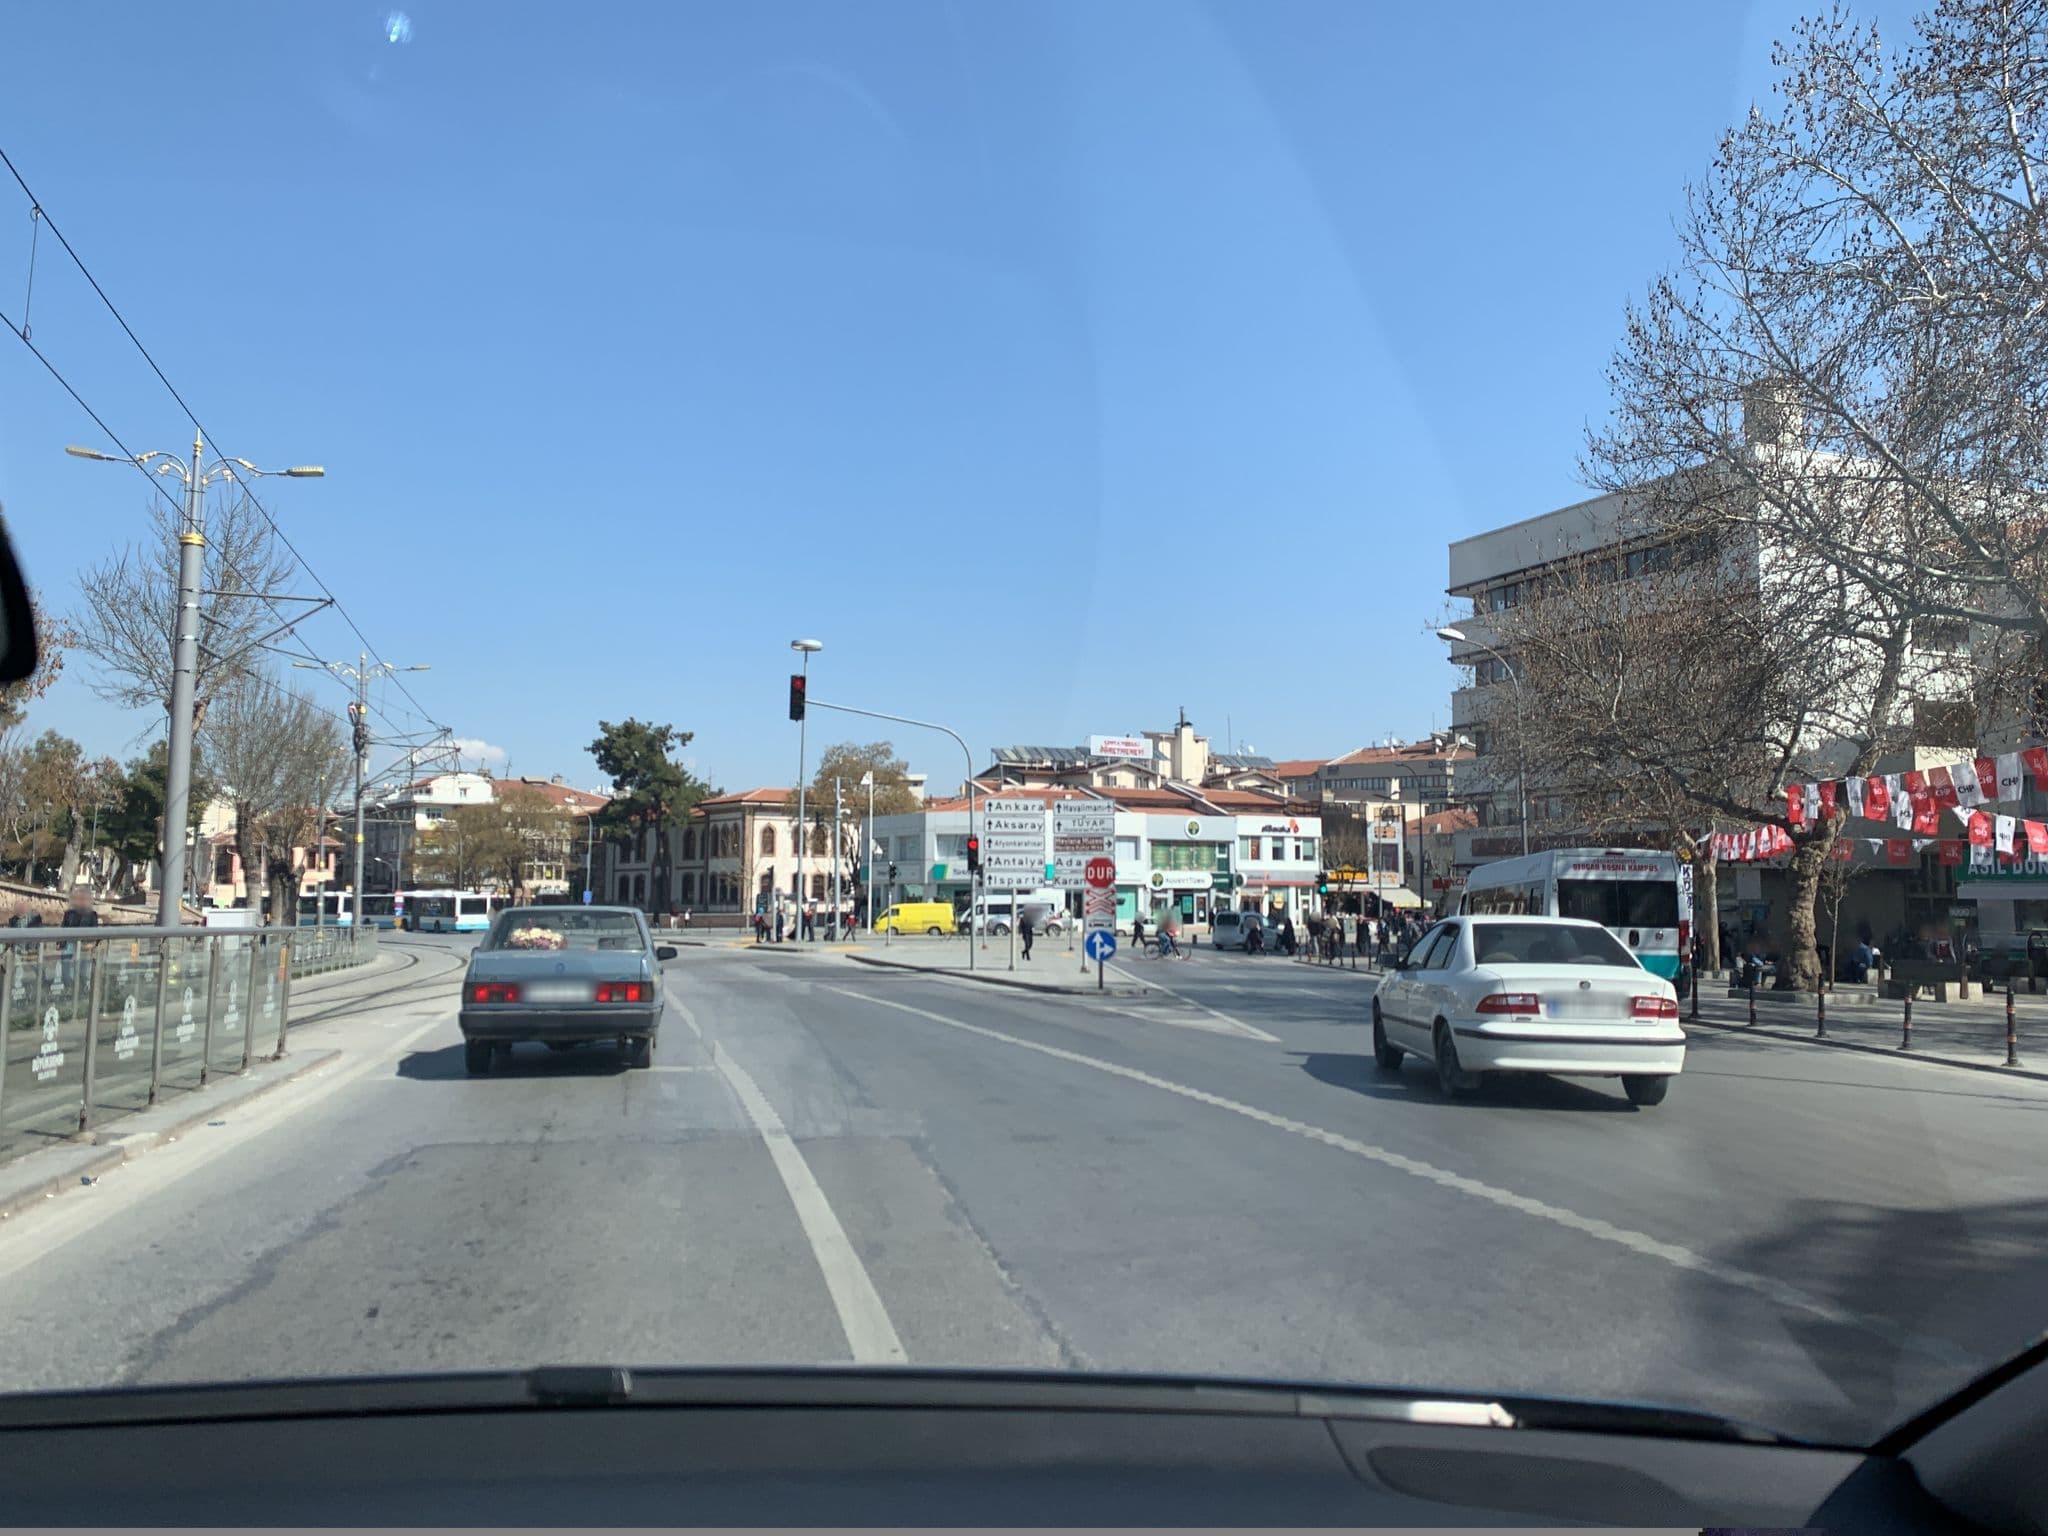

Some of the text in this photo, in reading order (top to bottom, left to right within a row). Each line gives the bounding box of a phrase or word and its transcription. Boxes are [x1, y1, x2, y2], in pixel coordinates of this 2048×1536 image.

[1958, 783, 1975, 794] CHP
[995, 802, 1044, 811] Ankara
[994, 820, 1043, 831] Aksaray
[994, 839, 1043, 848] Afyonkarahisar
[994, 857, 1043, 868] Antalya
[1087, 866, 1114, 880] DUR
[994, 876, 1044, 886] Isparta
